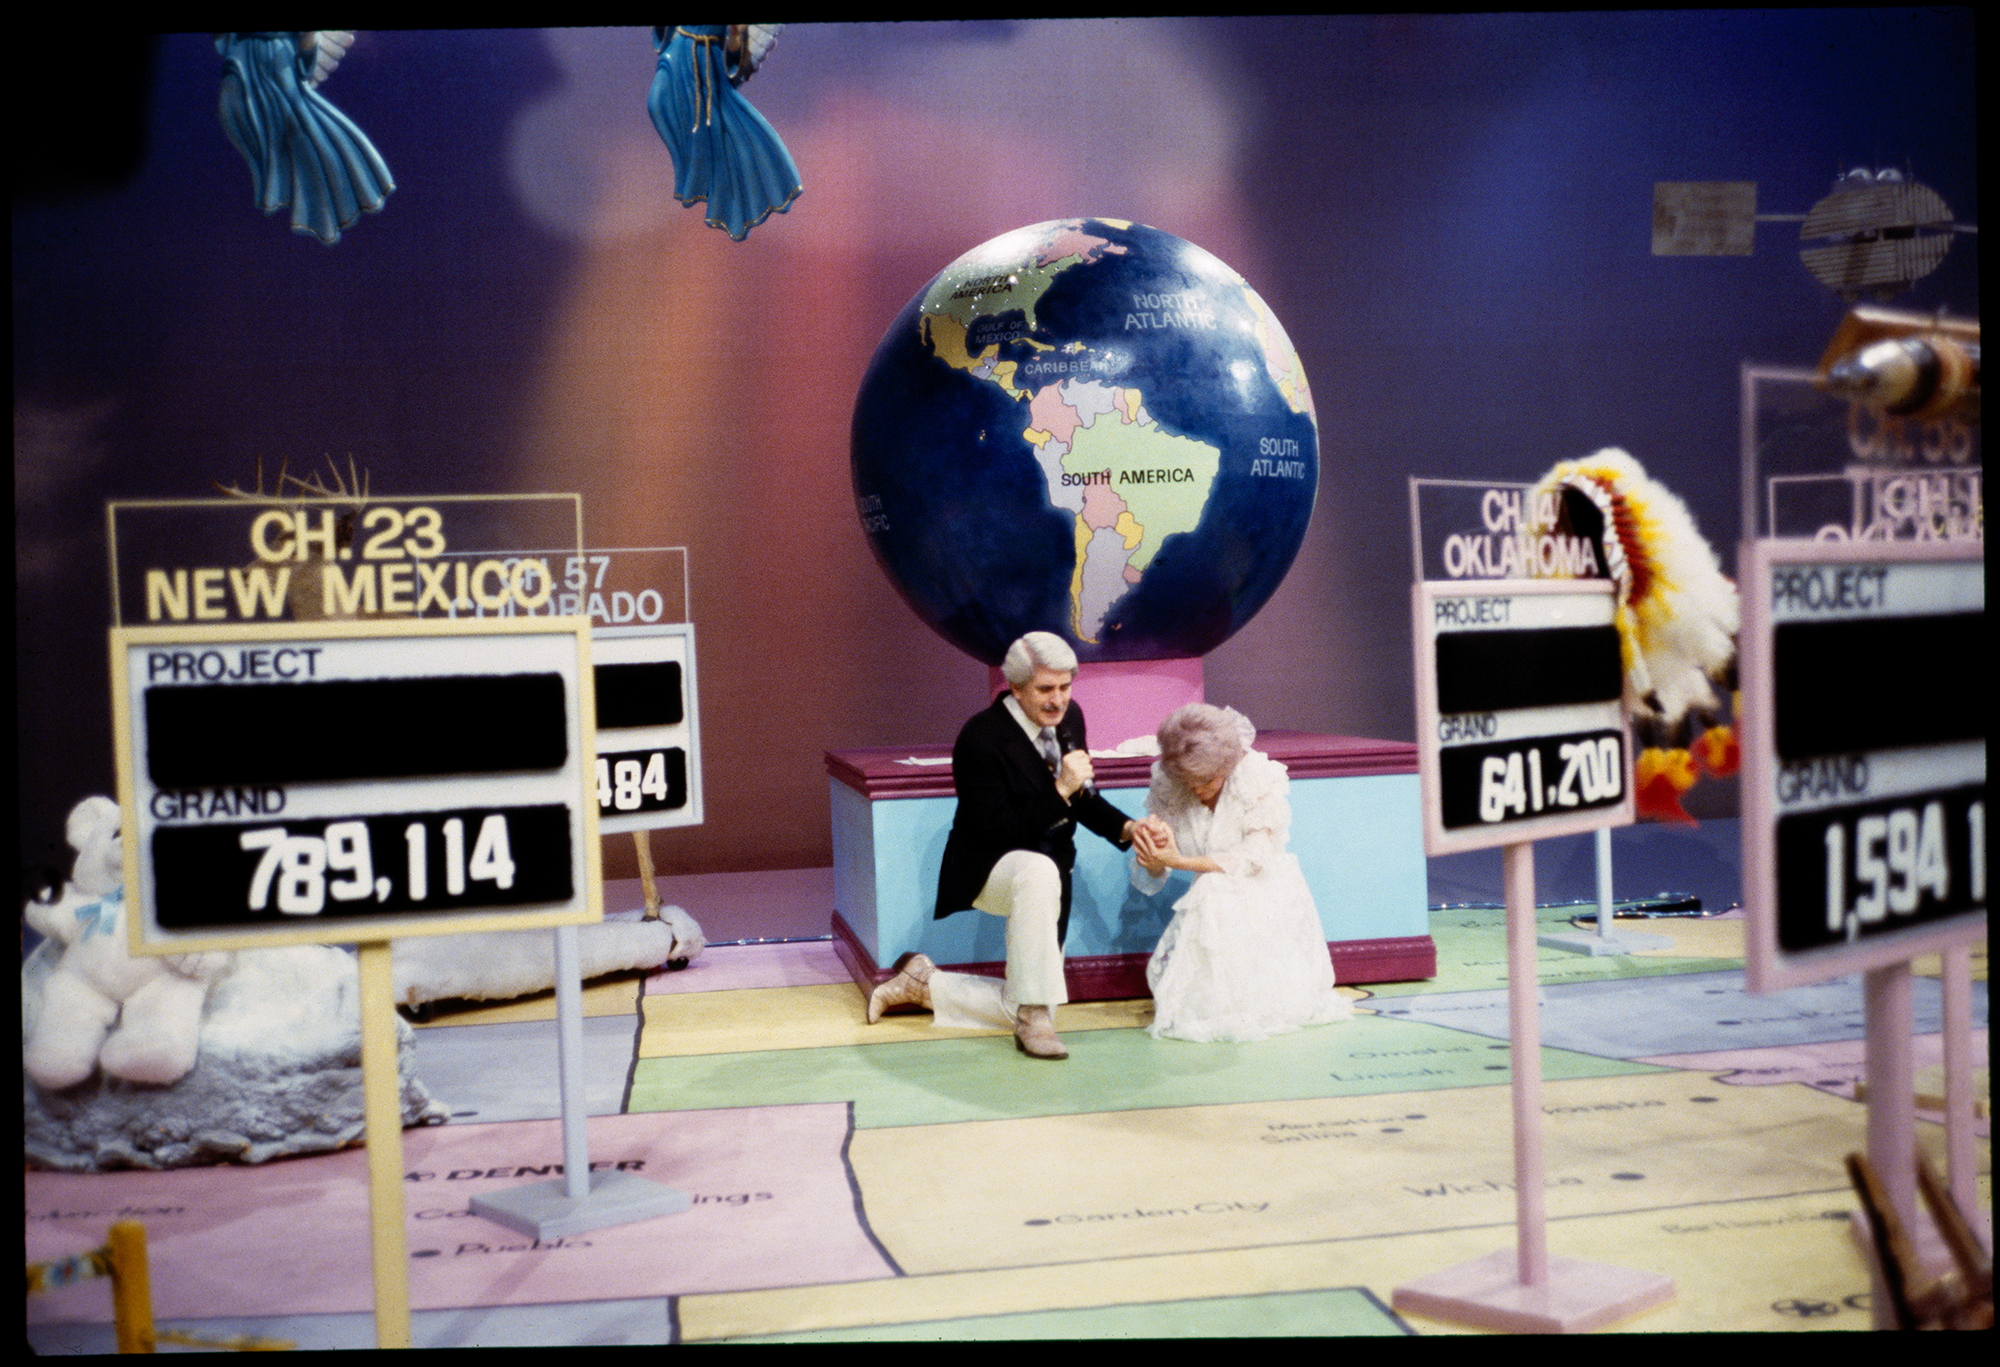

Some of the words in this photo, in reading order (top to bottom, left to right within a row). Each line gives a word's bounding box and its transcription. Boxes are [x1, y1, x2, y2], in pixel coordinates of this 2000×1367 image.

[950, 284, 1013, 301] AMERICA
[964, 275, 1010, 288] NORTH
[1133, 293, 1199, 310] NORTH
[976, 321, 1005, 333] GULF
[1009, 320, 1025, 331] OF
[1124, 312, 1217, 330] ATLANTIC
[975, 331, 1021, 345] MEXICO
[1024, 360, 1109, 375] CARIBBEAN
[1259, 436, 1299, 457] SOUTH
[1061, 472, 1111, 487] SOUTH
[1119, 468, 1195, 485] AMERICA
[1250, 458, 1306, 480] ATLANTIC
[1443, 533, 1599, 578] OKLAHOMA
[145, 566, 291, 620] NEW
[322, 557, 553, 616] MEXICO
[1773, 570, 1888, 609] PROJECT
[1434, 598, 1513, 625] PROJECT
[147, 647, 323, 683] PROJECT
[1438, 713, 1498, 742] GRAND
[1480, 737, 1622, 823] 641,200
[1779, 752, 1868, 802] GRAND
[149, 785, 288, 821] GRAND
[238, 814, 516, 915] 789,114
[445, 1159, 647, 1182] DENER
[454, 1237, 594, 1257] Pueblo
